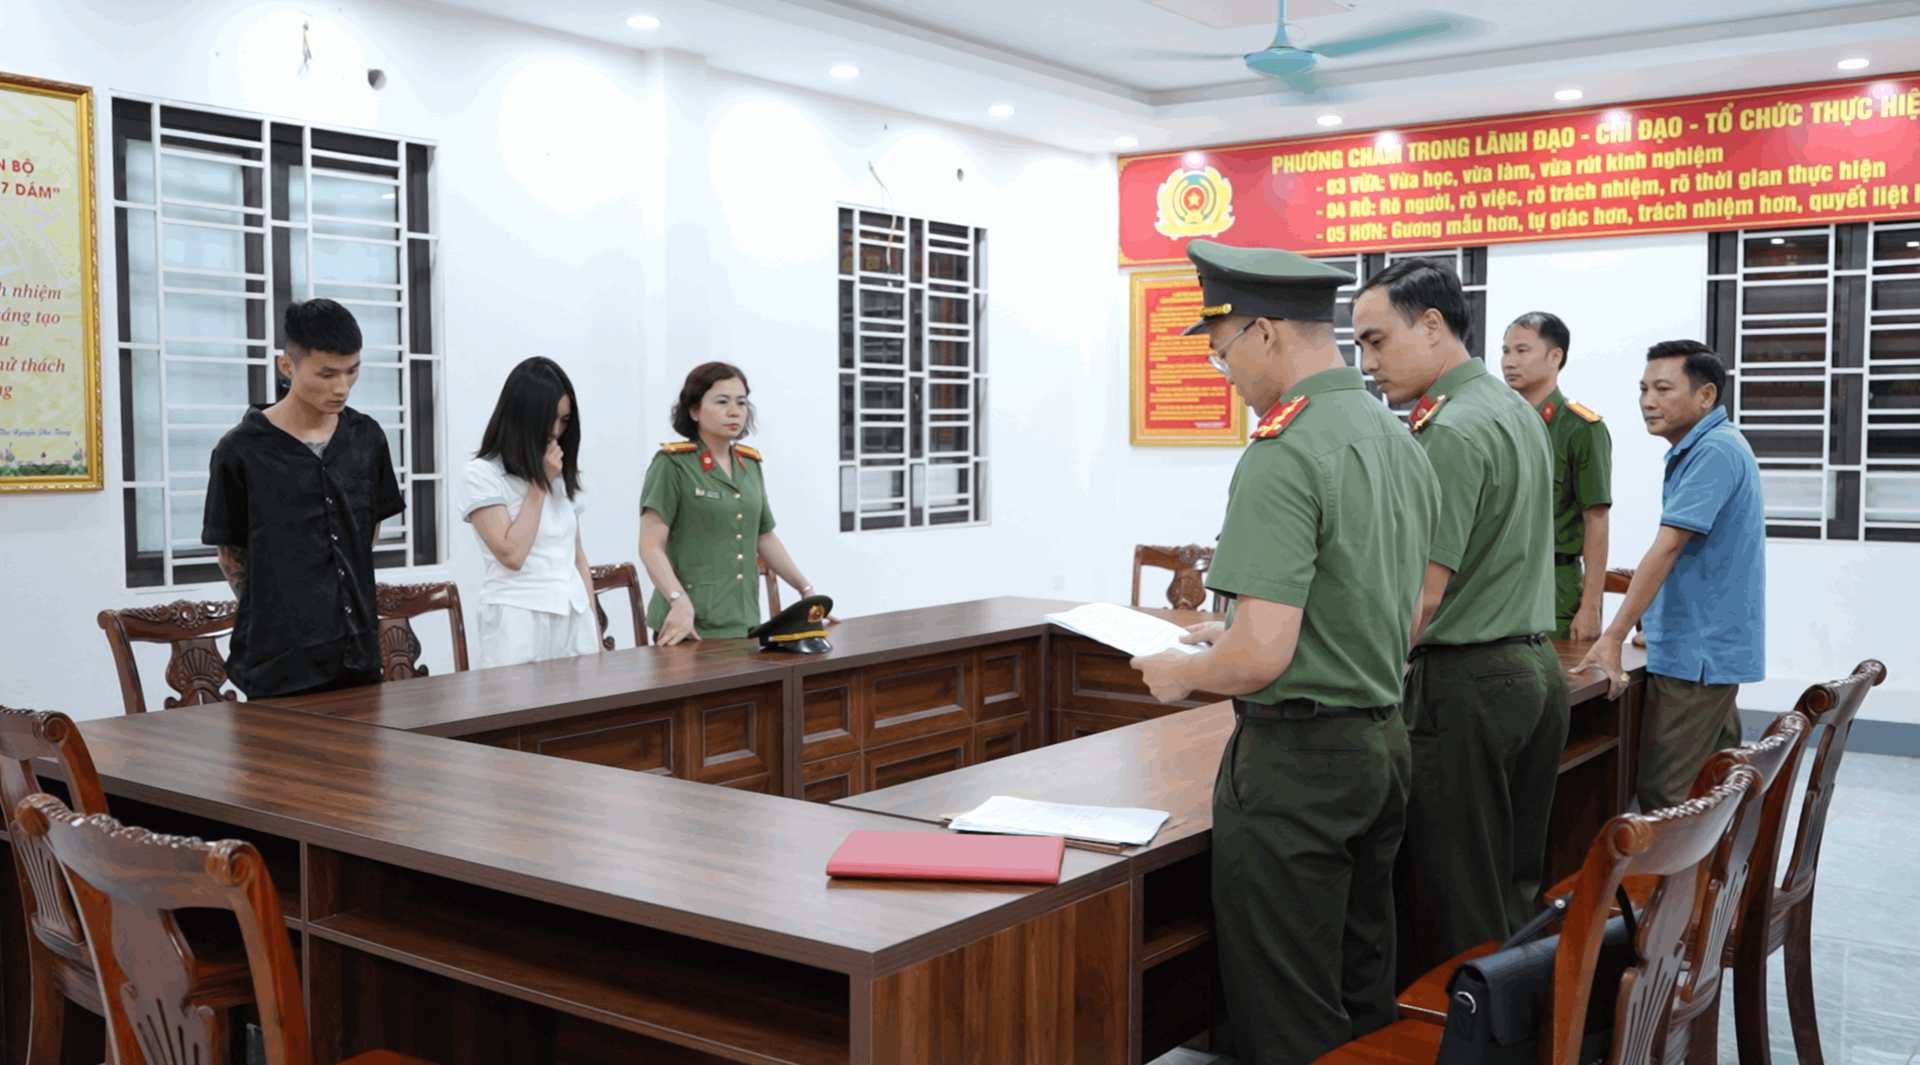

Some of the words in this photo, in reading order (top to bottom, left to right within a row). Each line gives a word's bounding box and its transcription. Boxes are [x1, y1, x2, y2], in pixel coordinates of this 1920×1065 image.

[1271, 150, 1343, 175] PHƯƠNG
[1406, 137, 1470, 162] TRONG
[1475, 131, 1528, 156] LÃNH
[1533, 127, 1575, 153] ĐẠO
[1638, 116, 1682, 144] ĐẠO
[1704, 102, 1733, 135] TỔ
[1739, 101, 1803, 131] CHỨC
[1810, 95, 1873, 126] THỰC
[12, 158, 35, 178] BỘ
[1326, 177, 1346, 196] 03
[1349, 172, 1386, 194] VỪA:
[1388, 171, 1419, 190] Vừa
[1423, 169, 1459, 191] học,
[1462, 164, 1493, 184] vừa
[1497, 162, 1536, 181] làm,
[1539, 158, 1572, 178] vừa
[1576, 154, 1602, 175] rút
[1606, 151, 1647, 172] kinh
[1652, 145, 1724, 169] nghiệm
[1, 181, 9, 194] 7
[1326, 201, 1346, 219] 04
[1349, 196, 1376, 218] RÕ:
[1379, 196, 1401, 215] Rõ
[1404, 193, 1456, 214] người,
[1459, 190, 1477, 209] rõ
[1481, 188, 1522, 211] việc,
[1527, 185, 1546, 204] rõ
[1550, 181, 1597, 202] trách
[1601, 177, 1665, 200] nhiệm,
[1670, 173, 1690, 194] rõ
[1695, 169, 1733, 191] thời
[1738, 168, 1783, 190] gian
[1788, 164, 1834, 187] thực
[1839, 158, 1886, 183] hiện
[1326, 225, 1346, 243] 05
[1349, 222, 1388, 242] HƠN:
[1391, 220, 1442, 239] Gương
[1446, 213, 1483, 235] mẫu
[1487, 214, 1524, 232] hơn,
[1528, 212, 1547, 233] tự
[1550, 207, 1589, 230] giác
[1593, 206, 1633, 226] hơn,
[1638, 201, 1687, 222] trách
[1692, 196, 1754, 220] nhiệm
[1759, 194, 1803, 214] hơn,
[1809, 184, 1867, 212] quyết
[1873, 184, 1909, 210] liệt
[13, 283, 61, 302] nhiệm
[0, 307, 31, 327] áng
[36, 311, 61, 327] tạo
[21, 357, 66, 373] thách
